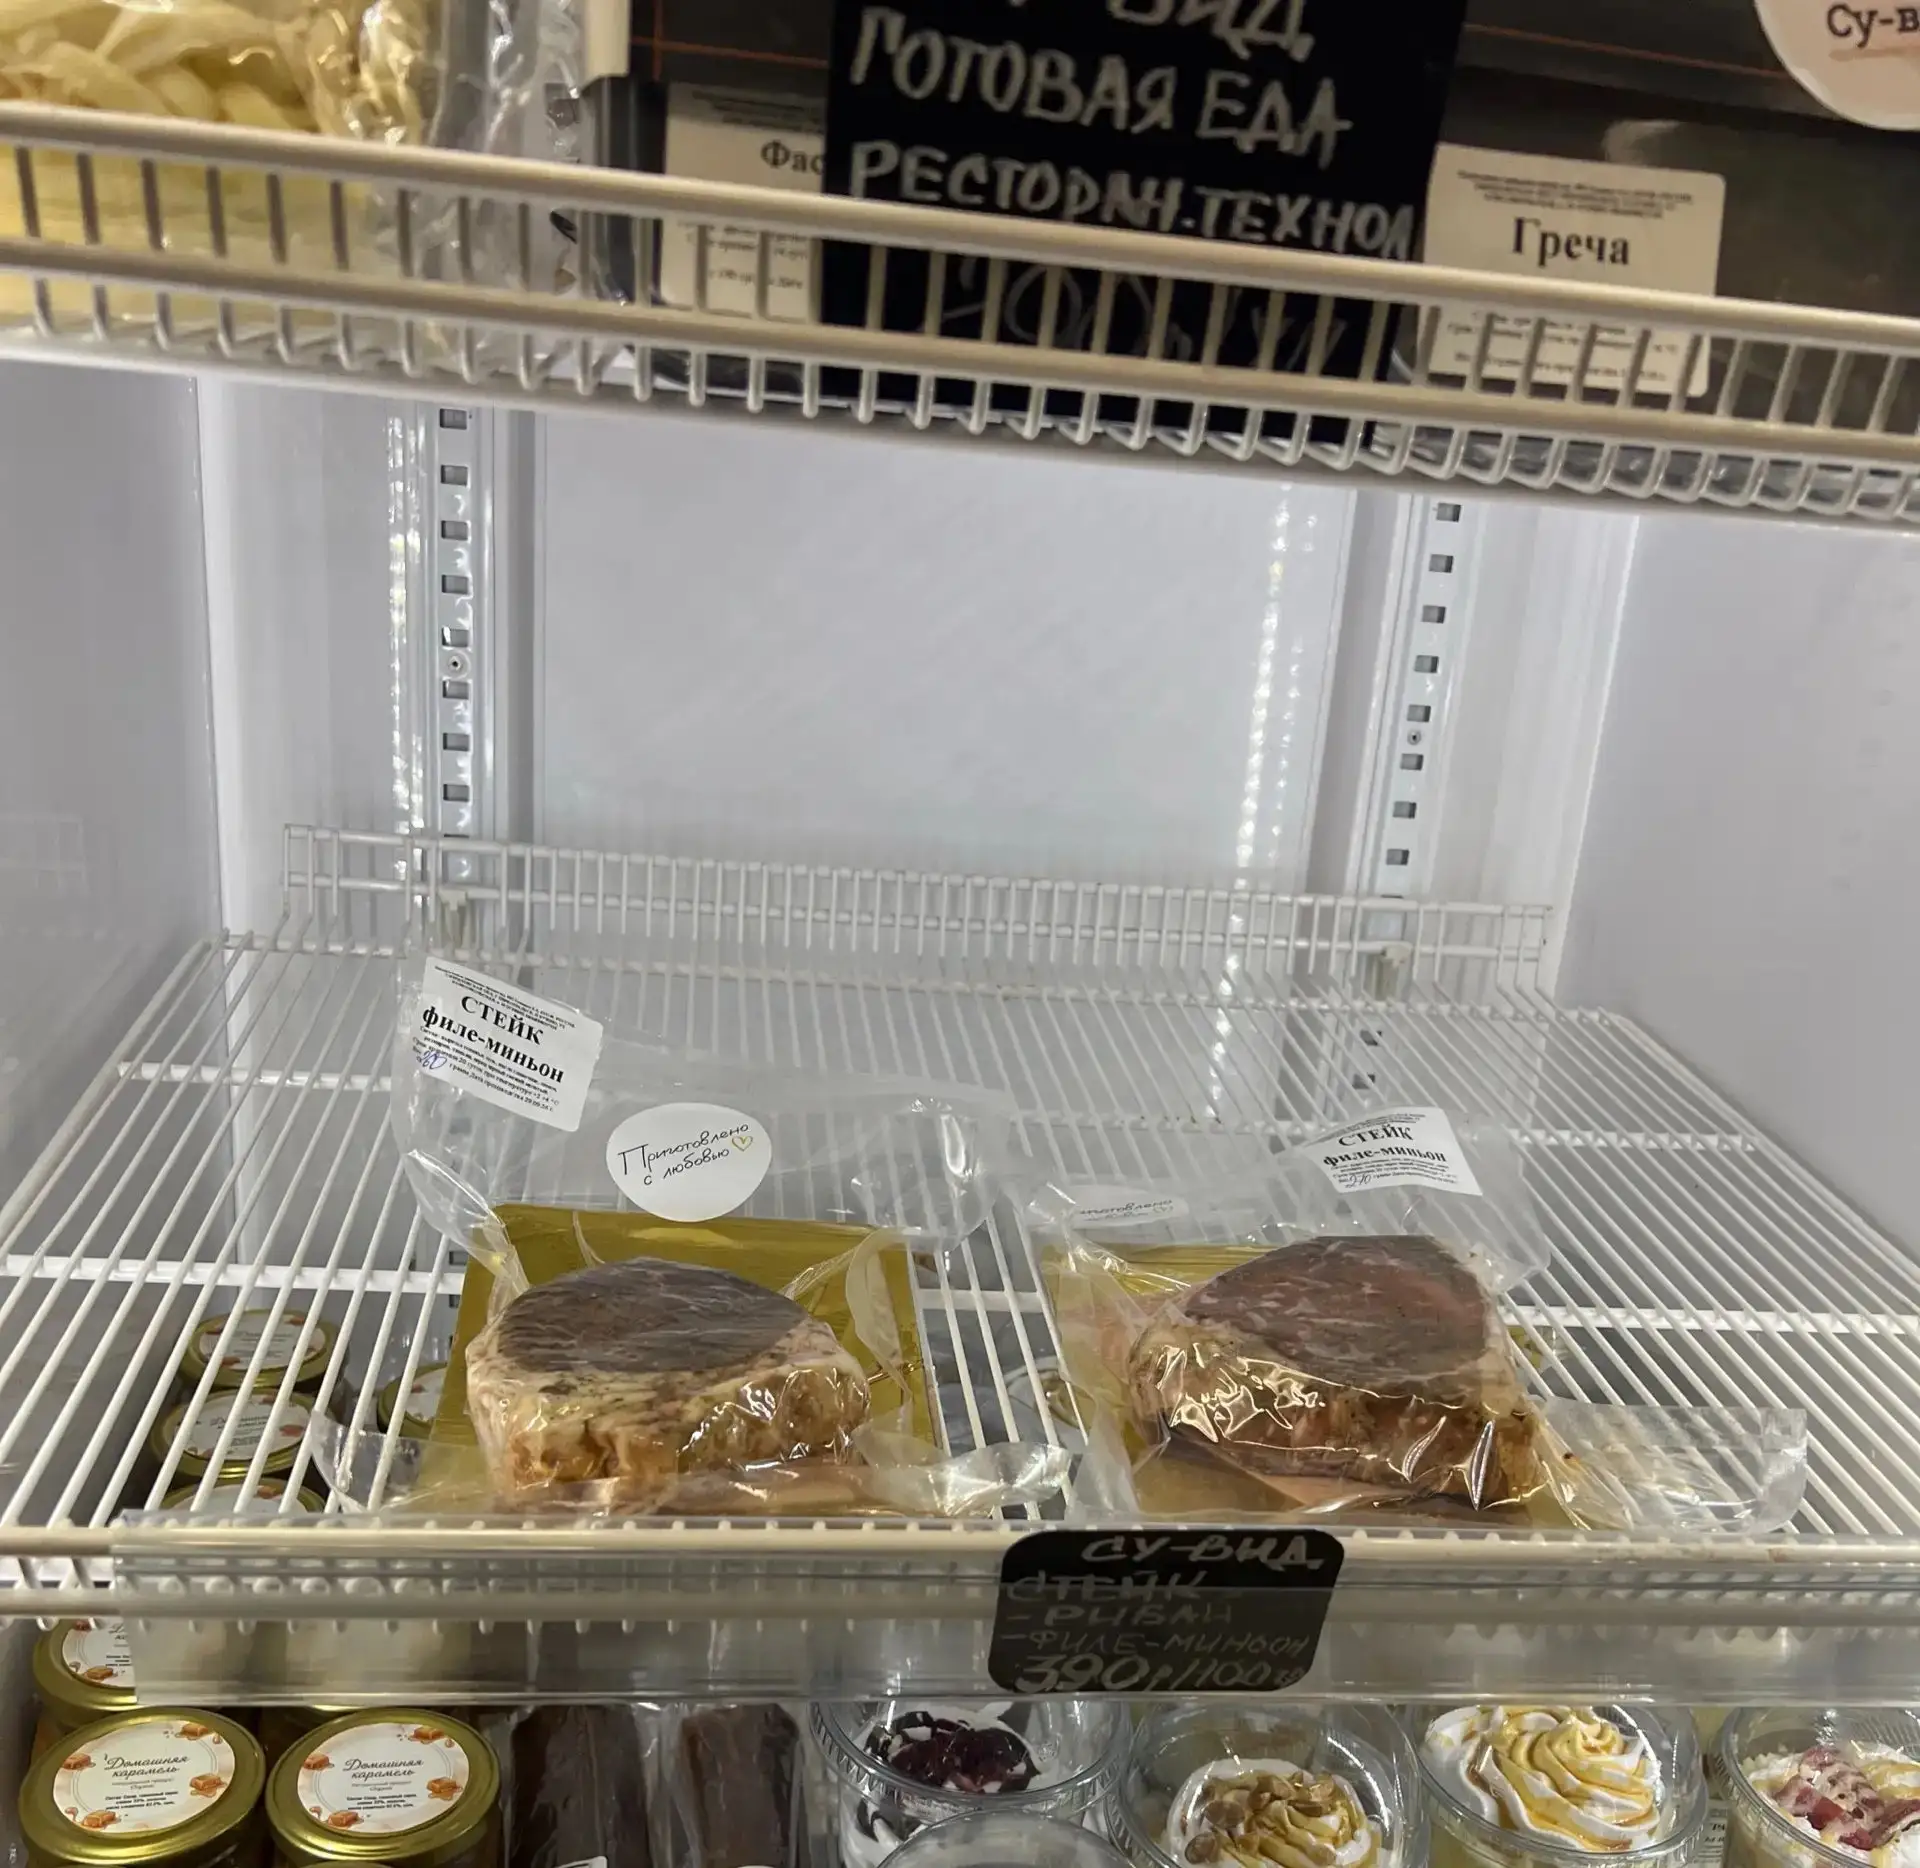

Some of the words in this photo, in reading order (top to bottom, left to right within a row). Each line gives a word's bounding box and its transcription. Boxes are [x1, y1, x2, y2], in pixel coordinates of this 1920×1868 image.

[850, 5, 1177, 134] ГОТОВАЯ
[1195, 68, 1354, 170] ЕДА
[1511, 216, 1631, 268] Греча
[461, 995, 544, 1045] СТЕЙК
[422, 1006, 565, 1083] филе-миньон
[618, 1123, 749, 1176] Приготовлено
[1338, 1124, 1413, 1147] СТЕЙК
[643, 1175, 653, 1186] с
[663, 1148, 730, 1179] любовью
[1323, 1146, 1447, 1167] филе-миньон
[1081, 1535, 1325, 1572] СУ-ВИД
[1006, 1570, 1208, 1602] СТЕЙК
[104, 1756, 189, 1771] Домашняя
[112, 1767, 180, 1780] карамель
[342, 1758, 423, 1772] Домашняя
[351, 1769, 415, 1782] карамель
